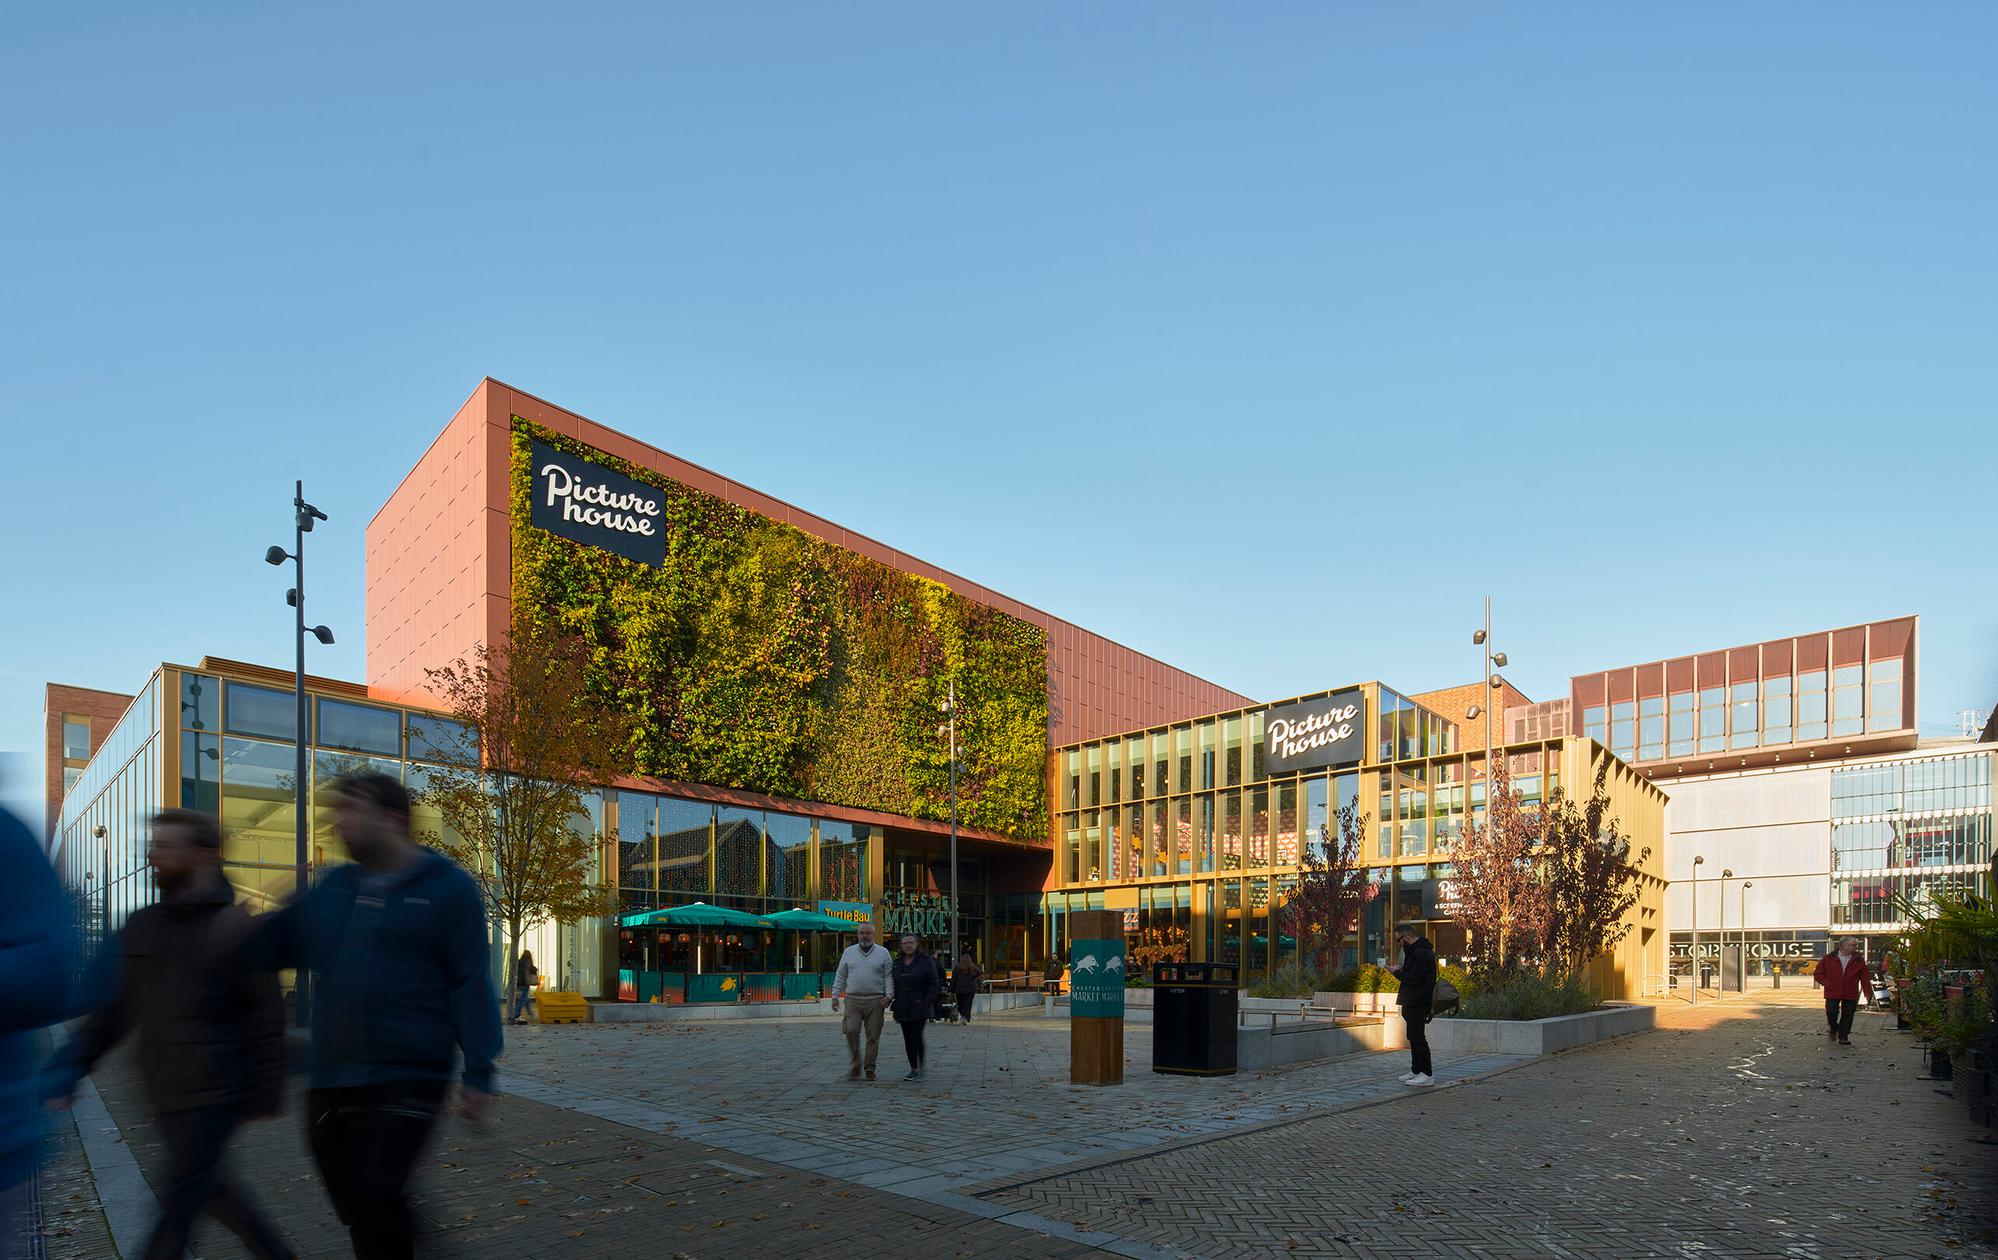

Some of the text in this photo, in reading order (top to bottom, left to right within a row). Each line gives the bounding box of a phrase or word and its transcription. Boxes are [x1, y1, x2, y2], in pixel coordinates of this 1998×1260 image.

[541, 464, 660, 516] Picture
[563, 496, 655, 536] house
[1267, 704, 1359, 755] Picture
[1282, 723, 1354, 759] house
[883, 906, 959, 937] MARKE
[1072, 991, 1100, 1002] MARKET
